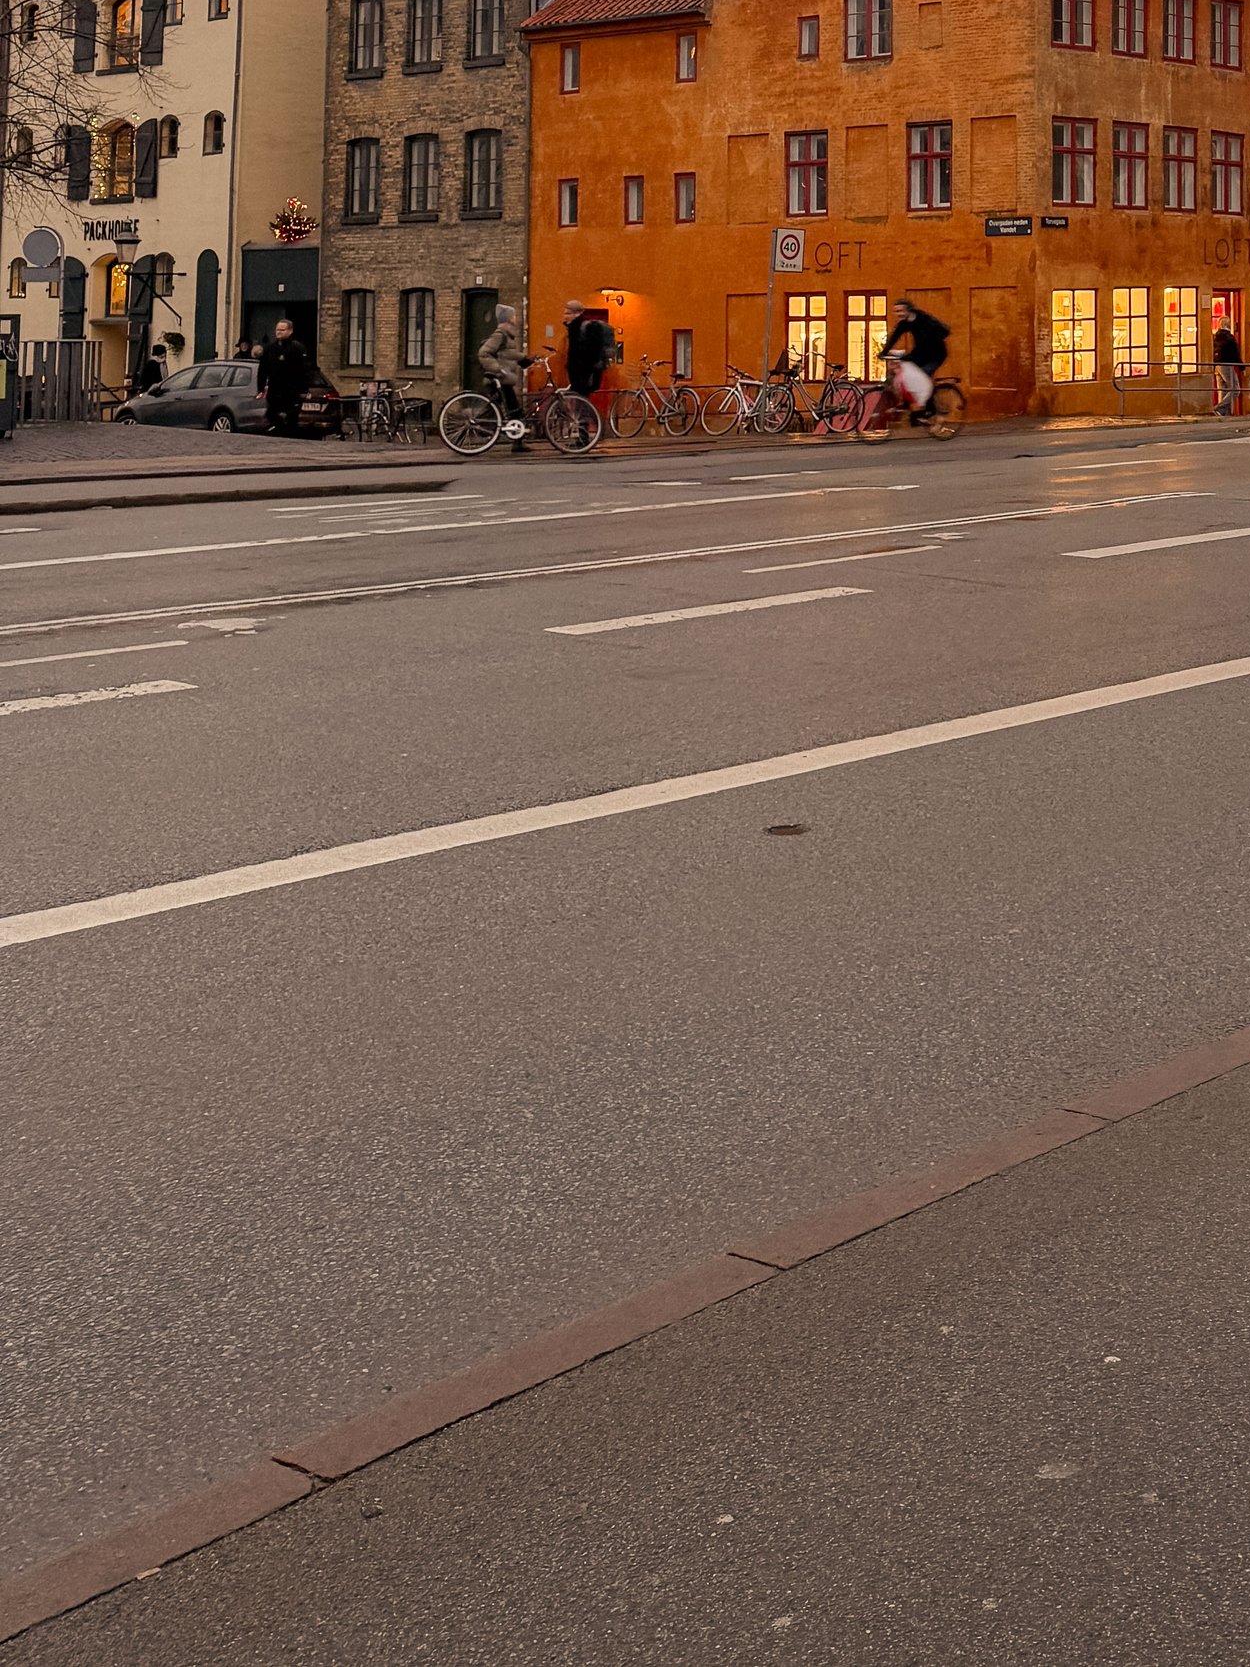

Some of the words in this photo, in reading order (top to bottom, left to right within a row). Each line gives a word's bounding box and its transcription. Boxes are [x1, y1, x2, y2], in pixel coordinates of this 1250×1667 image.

[83, 219, 140, 241] PACKHOE
[783, 241, 797, 253] 40
[803, 240, 867, 270] OFT
